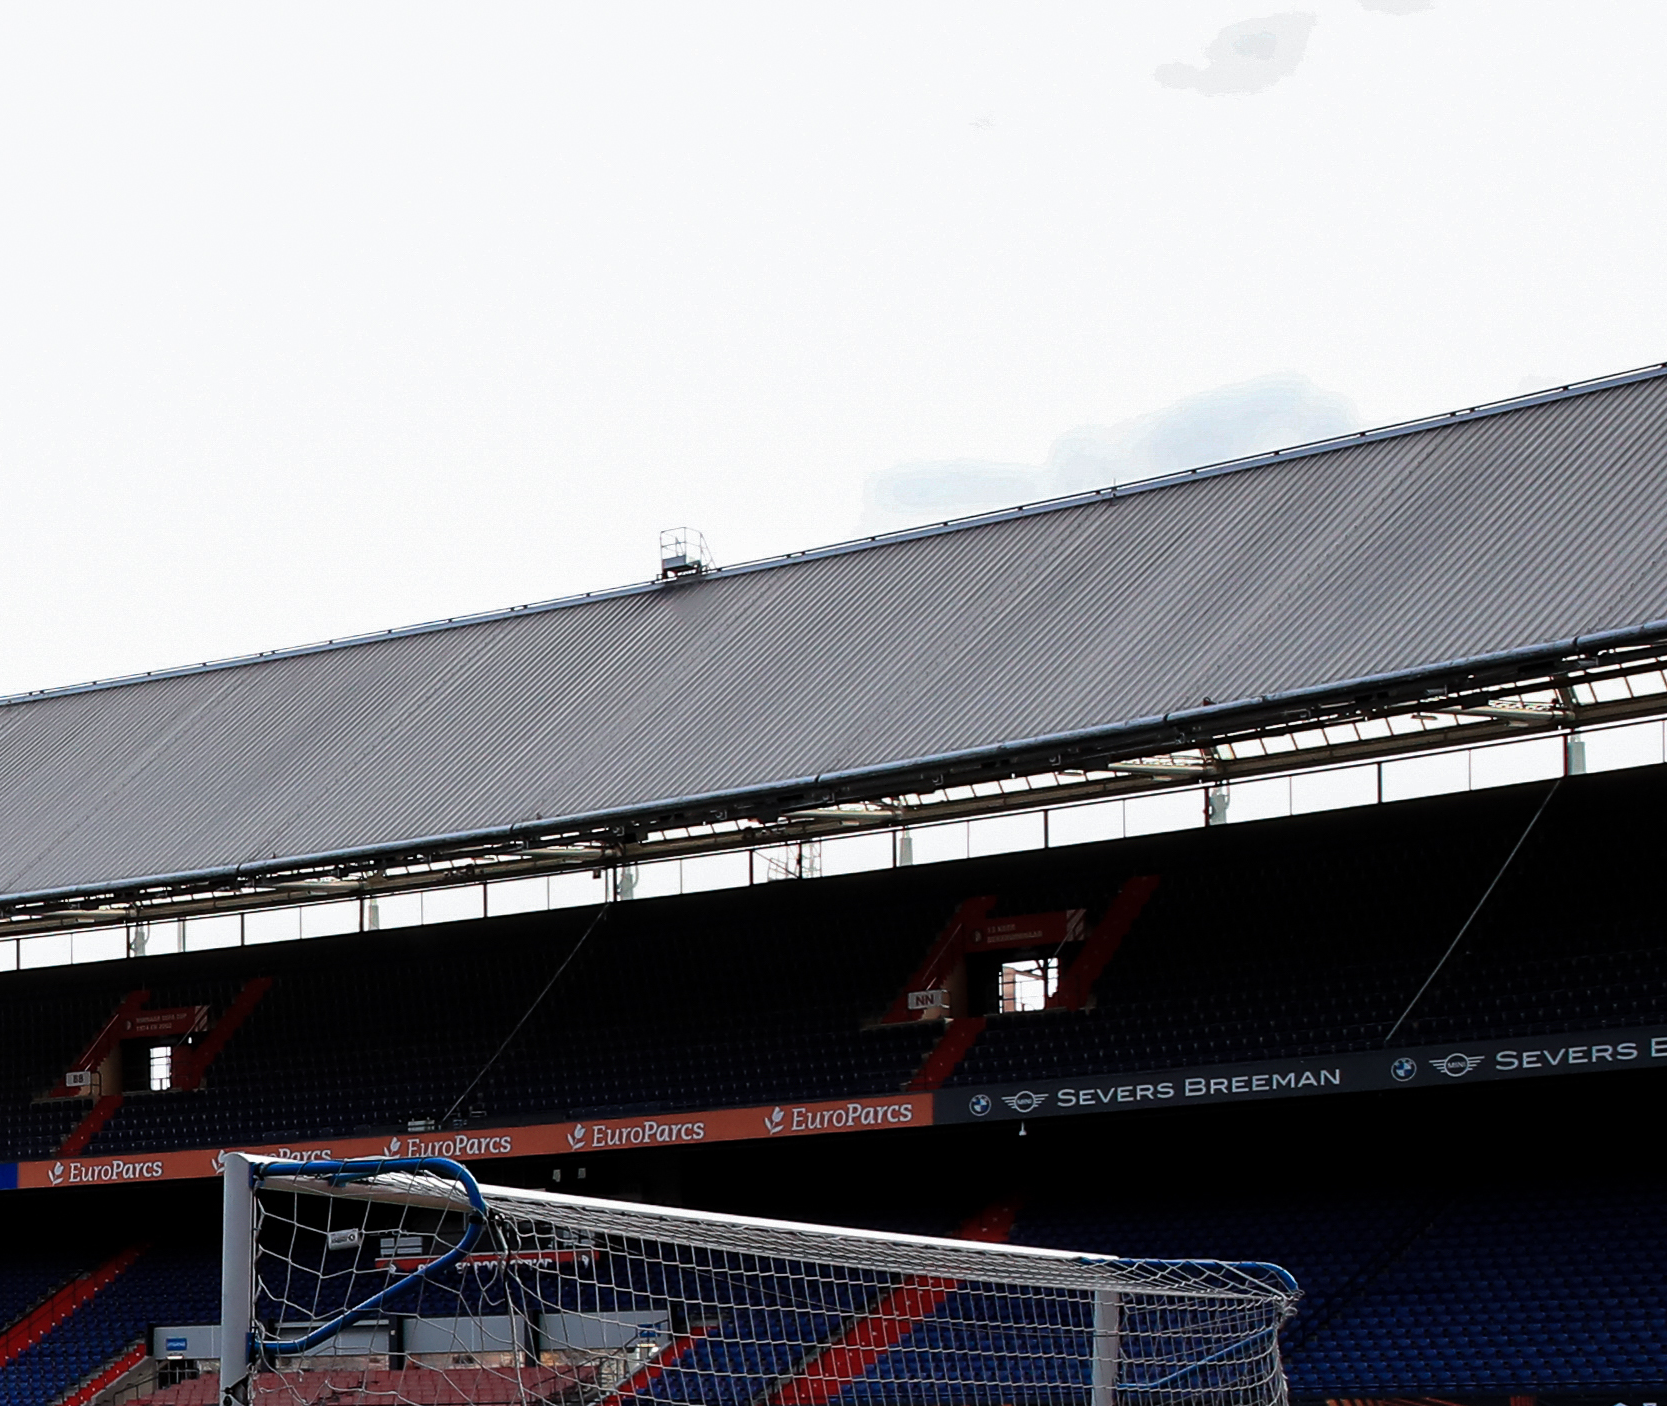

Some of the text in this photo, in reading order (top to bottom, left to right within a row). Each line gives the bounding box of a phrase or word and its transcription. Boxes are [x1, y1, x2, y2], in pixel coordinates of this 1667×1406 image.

[916, 994, 934, 1006] NN
[791, 1103, 912, 1131] EuroParcs
[592, 1121, 704, 1148] EuroParcs
[407, 1136, 511, 1159] EuroParcs
[69, 1160, 163, 1183] EuroParcs
